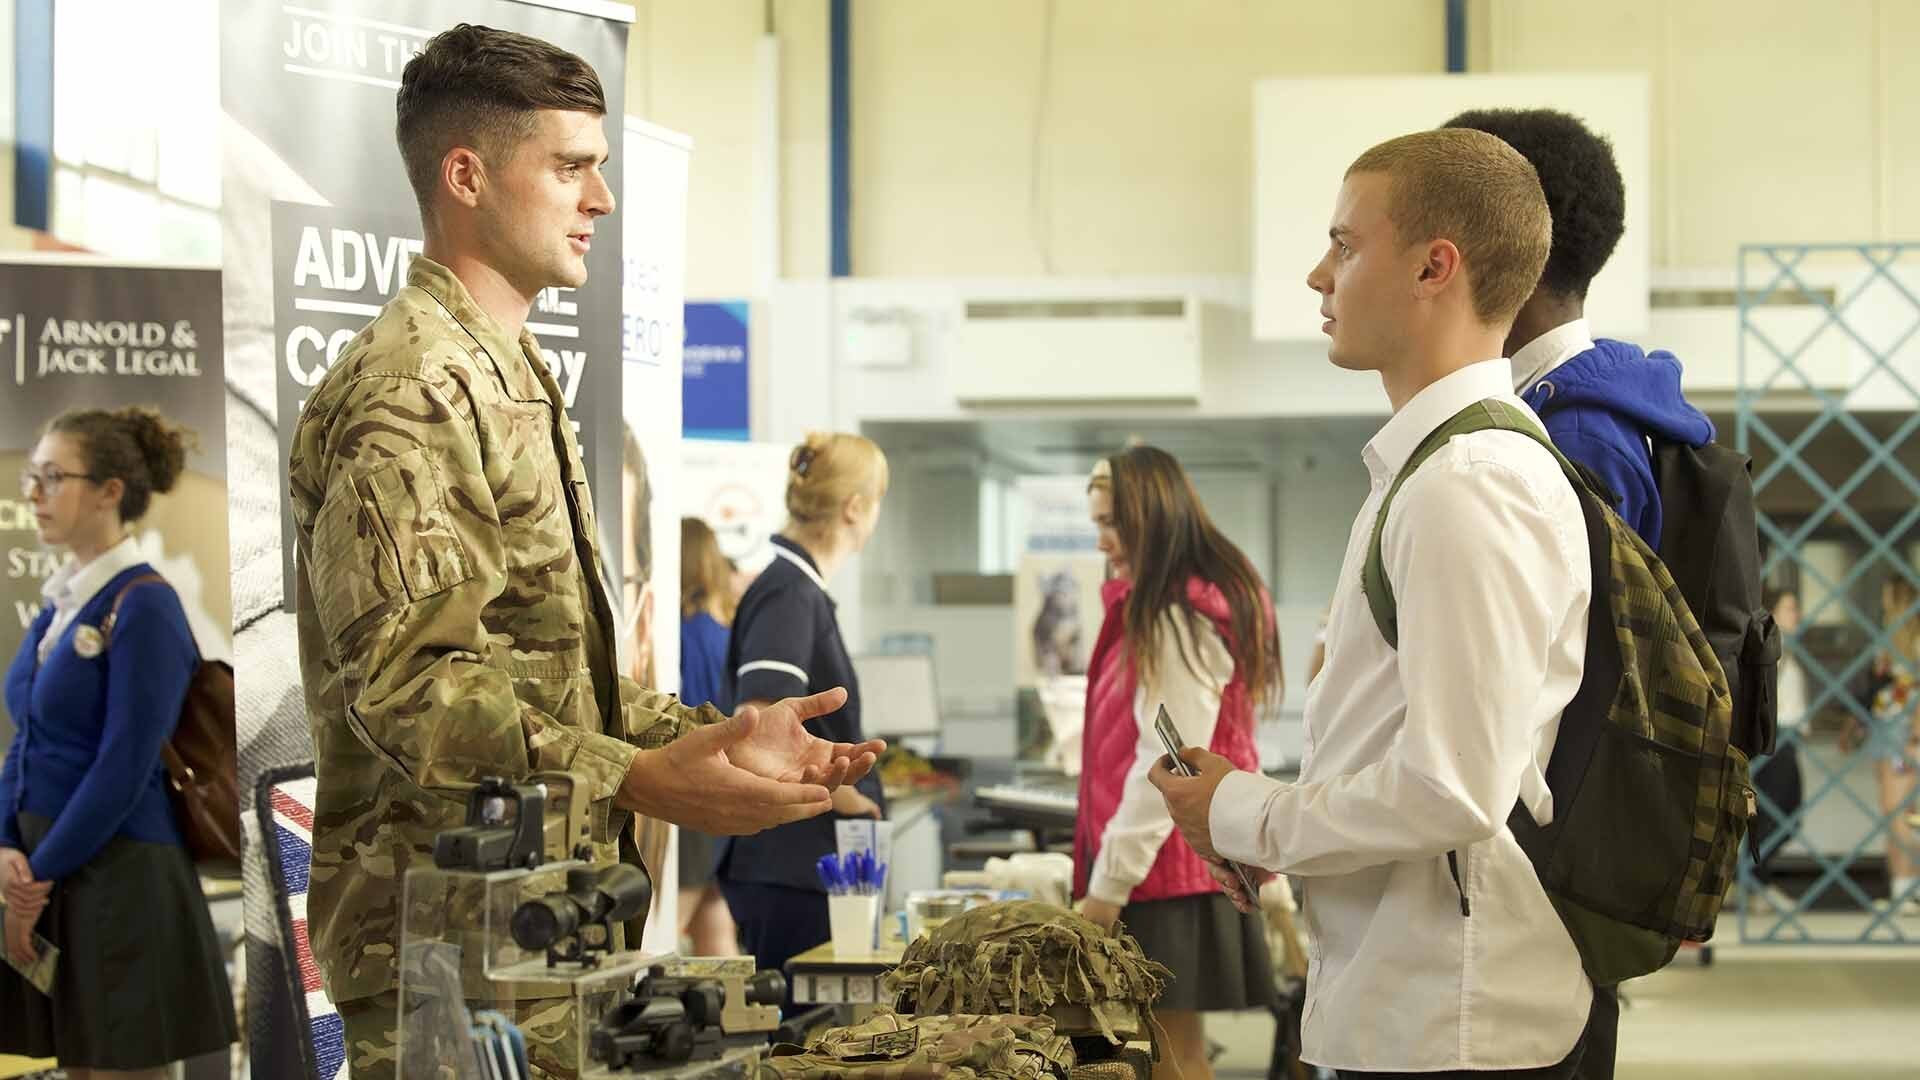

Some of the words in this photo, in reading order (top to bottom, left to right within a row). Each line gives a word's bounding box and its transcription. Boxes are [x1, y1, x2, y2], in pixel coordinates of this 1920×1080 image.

[283, 20, 367, 69] JOIN
[377, 35, 425, 74] TH
[40, 317, 167, 348] ARNOLD
[171, 320, 198, 349] &
[37, 344, 108, 378] JACK
[115, 347, 202, 377] LEGAL
